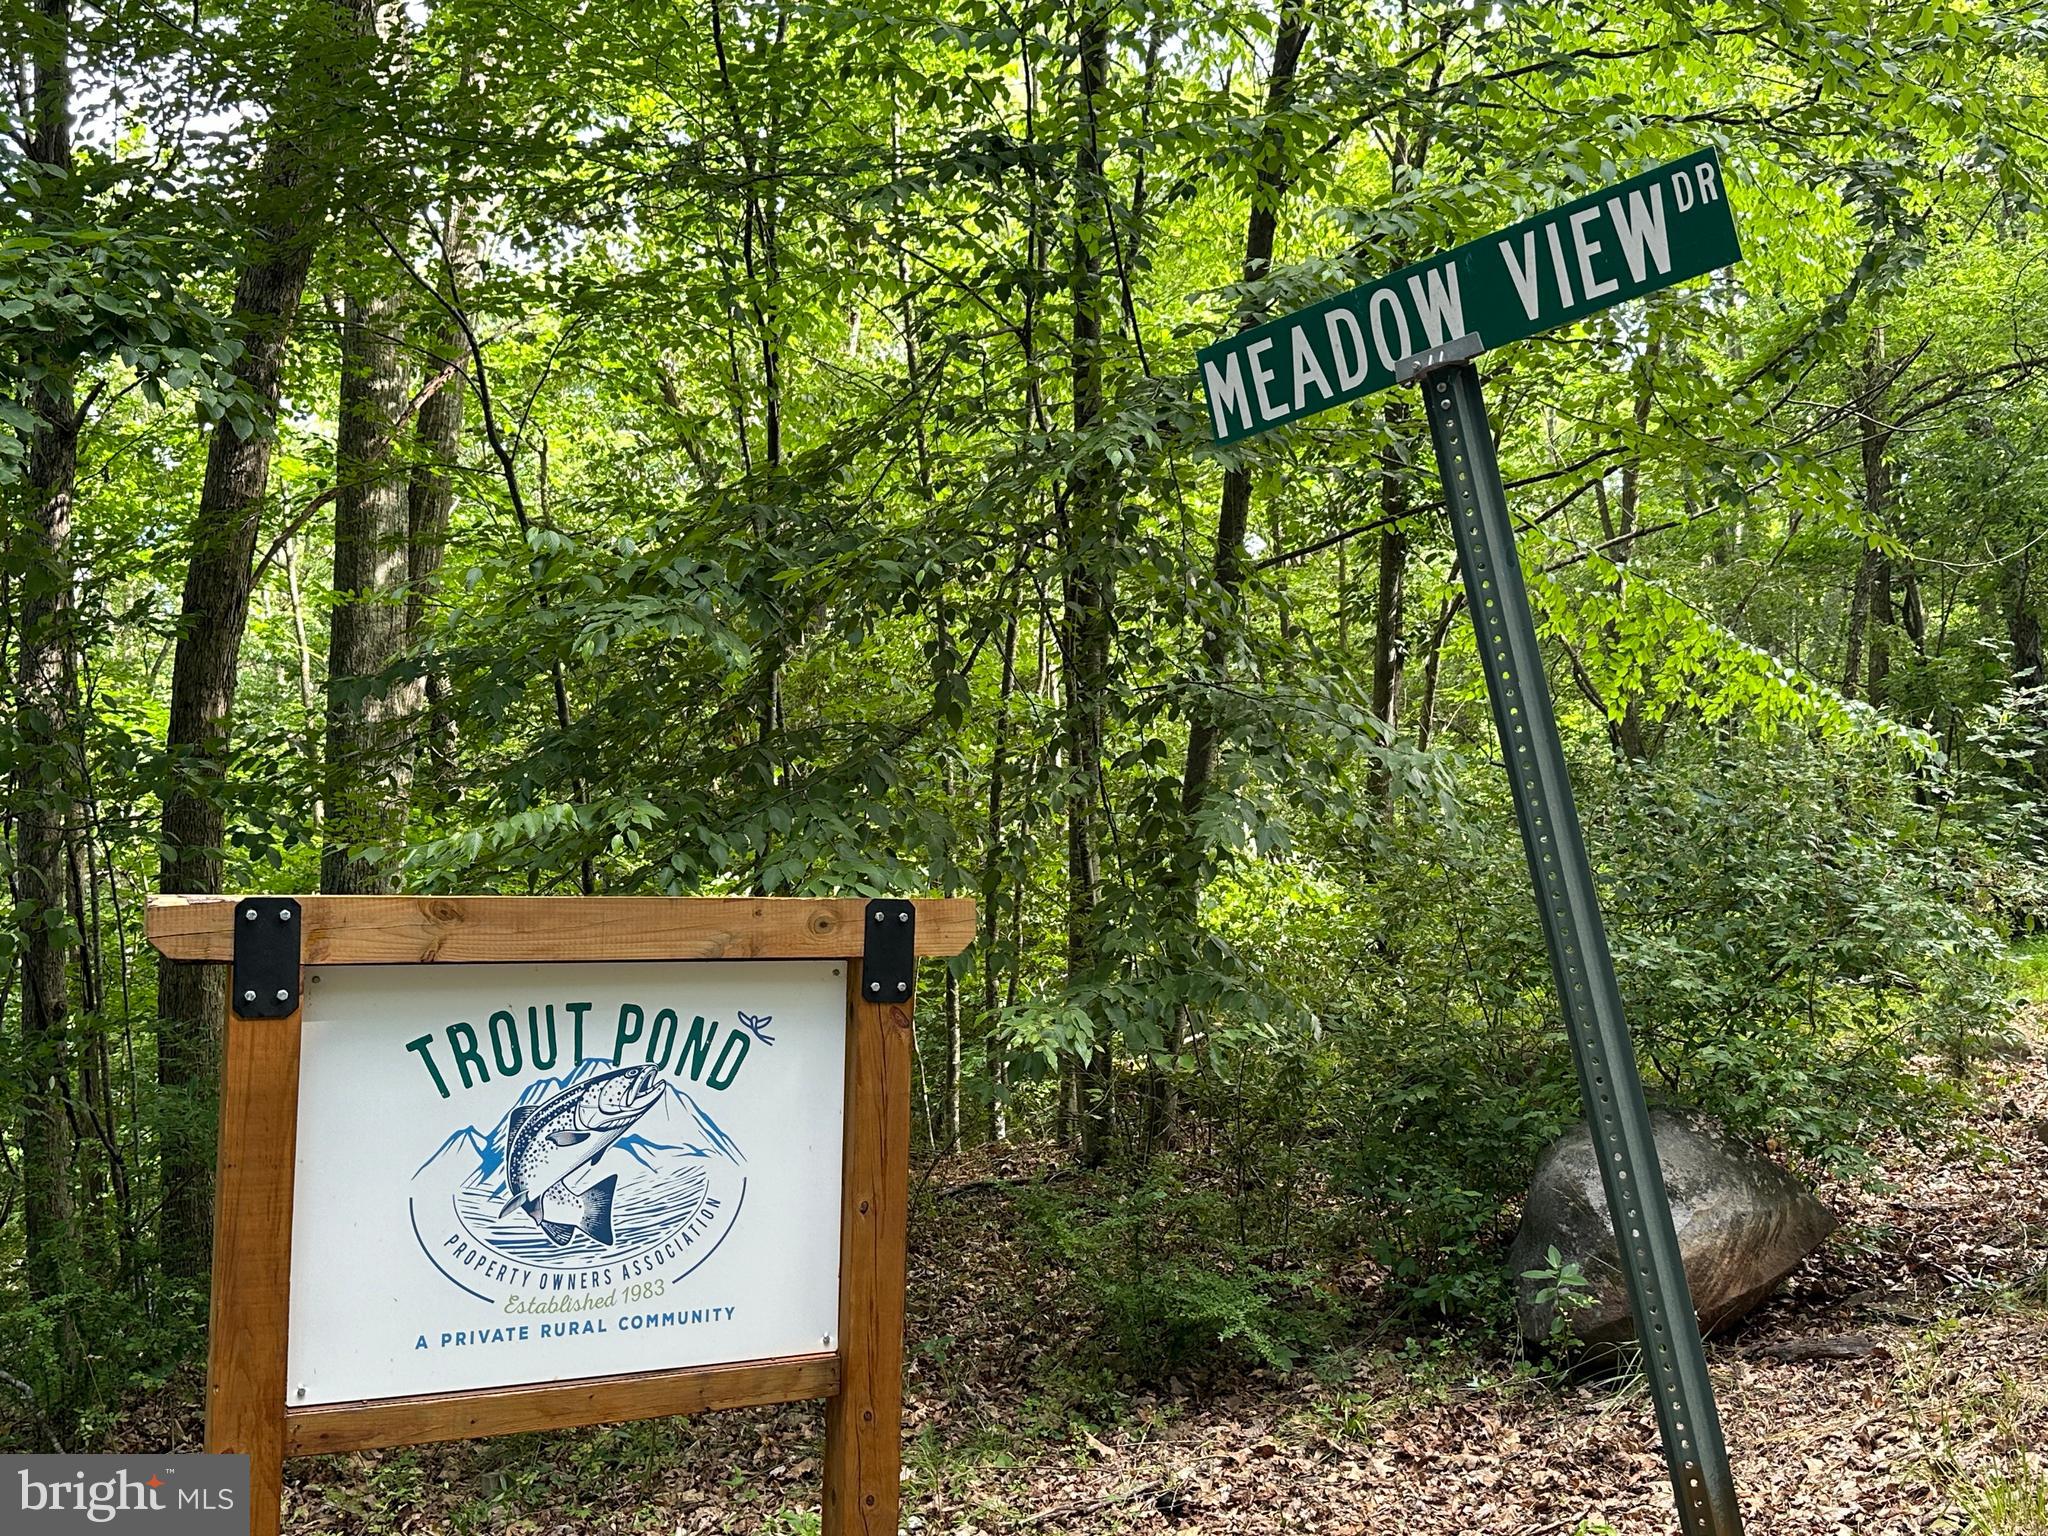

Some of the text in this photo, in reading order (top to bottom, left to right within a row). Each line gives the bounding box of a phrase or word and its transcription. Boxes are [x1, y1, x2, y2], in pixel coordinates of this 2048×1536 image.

[1203, 161, 1719, 440] MEADOW VIEW DR
[405, 1002, 751, 1098] TROUT POND
[443, 1196, 721, 1291] PROPERTY OWNERS ASSOCIATION
[415, 1306, 737, 1350] A PRIVATE RURAL COMMUNITY
[504, 1278, 665, 1315] Established 1983
